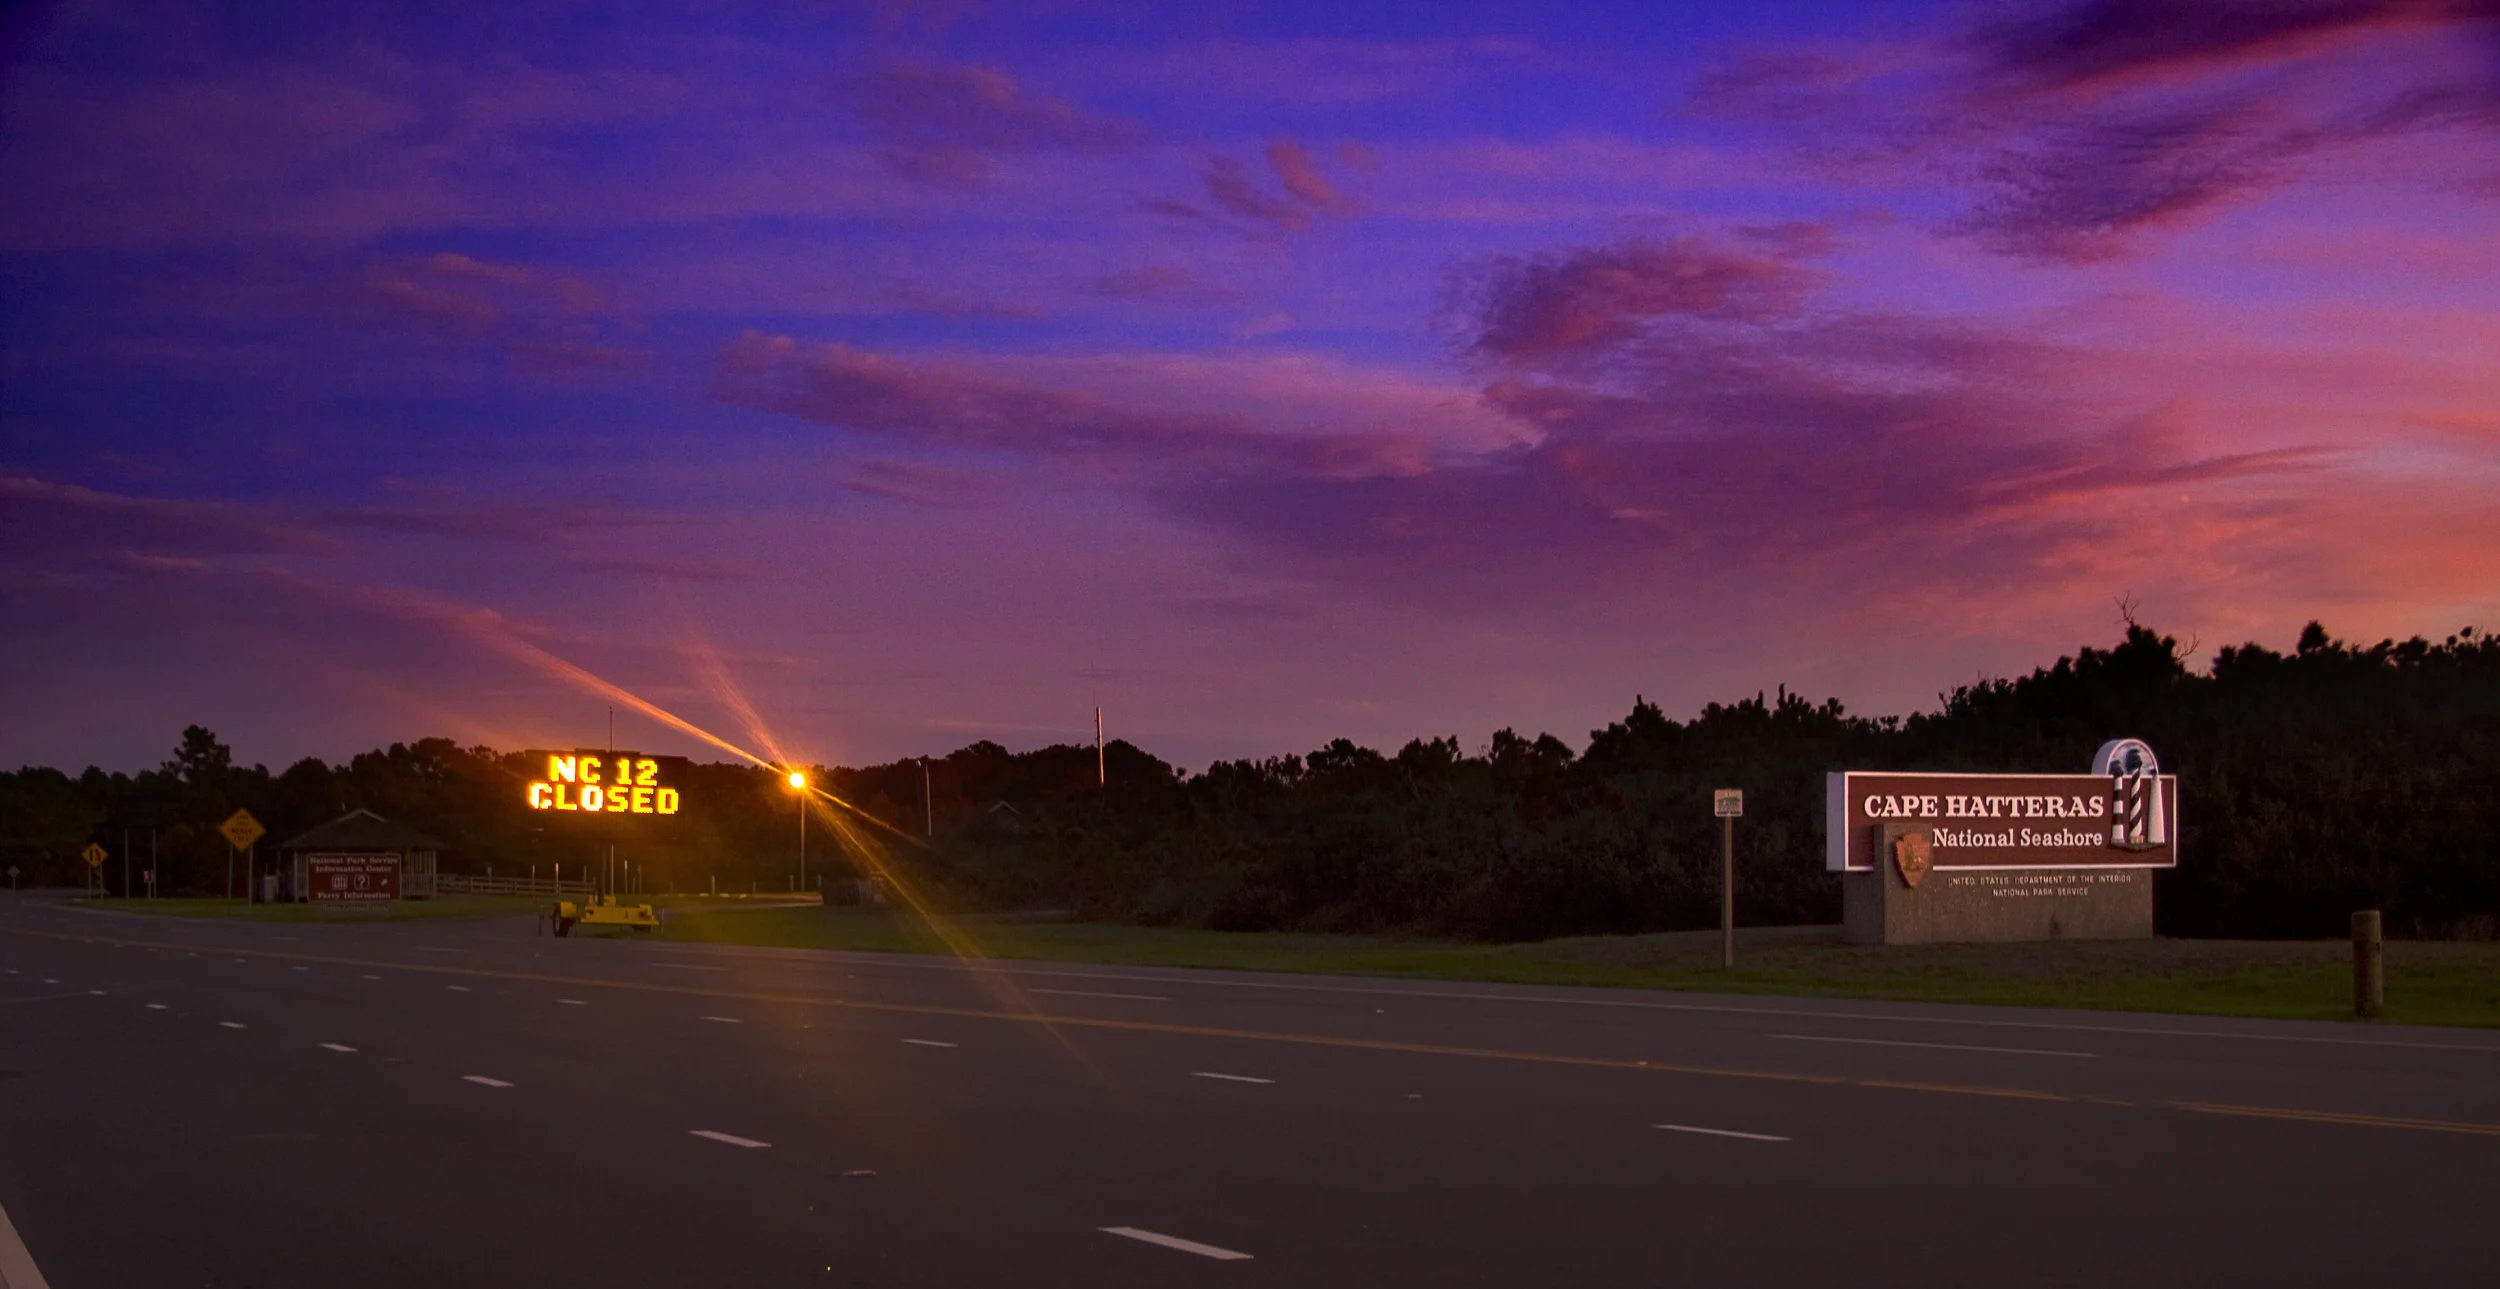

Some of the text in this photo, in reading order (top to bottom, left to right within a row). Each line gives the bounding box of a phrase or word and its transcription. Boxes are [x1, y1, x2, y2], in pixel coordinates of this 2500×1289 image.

[549, 755, 658, 786] NC 12
[528, 782, 680, 815] CLOSED
[1864, 795, 2104, 818] CAPE HATTERAS
[1932, 827, 2103, 847] National Seashore
[316, 865, 392, 873] Information Center
[1948, 874, 2131, 885] UNITED STATES DEPARTMENT OF THE INTERIOR
[1993, 887, 2088, 896] NATIONAL PARK SERVICE
